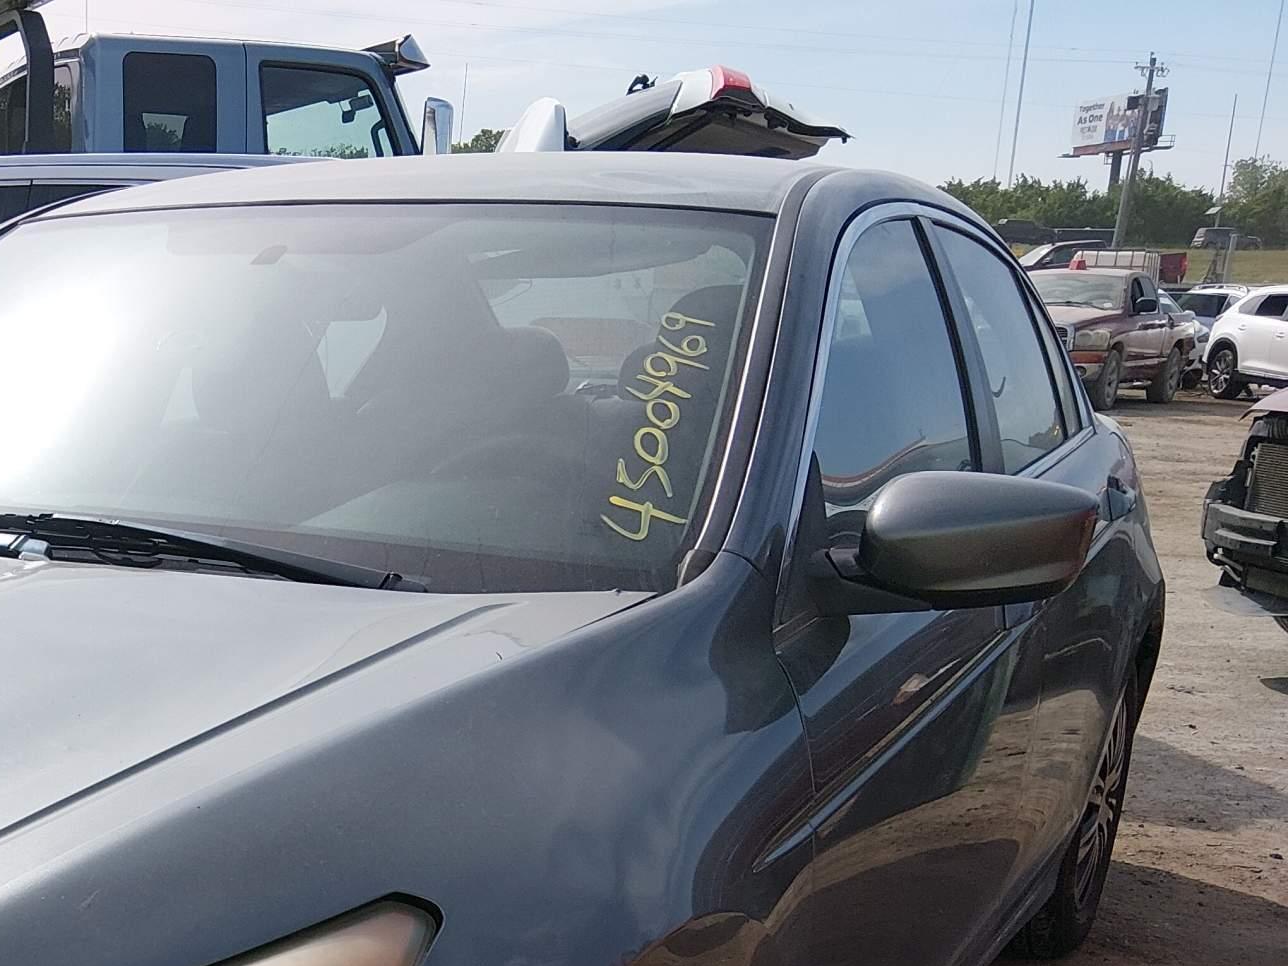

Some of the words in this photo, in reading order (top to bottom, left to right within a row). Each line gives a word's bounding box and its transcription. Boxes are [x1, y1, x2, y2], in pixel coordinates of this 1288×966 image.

[1079, 103, 1105, 113] Together
[1077, 116, 1088, 126] As
[1088, 114, 1103, 123] One
[599, 311, 716, 541] 45004969
